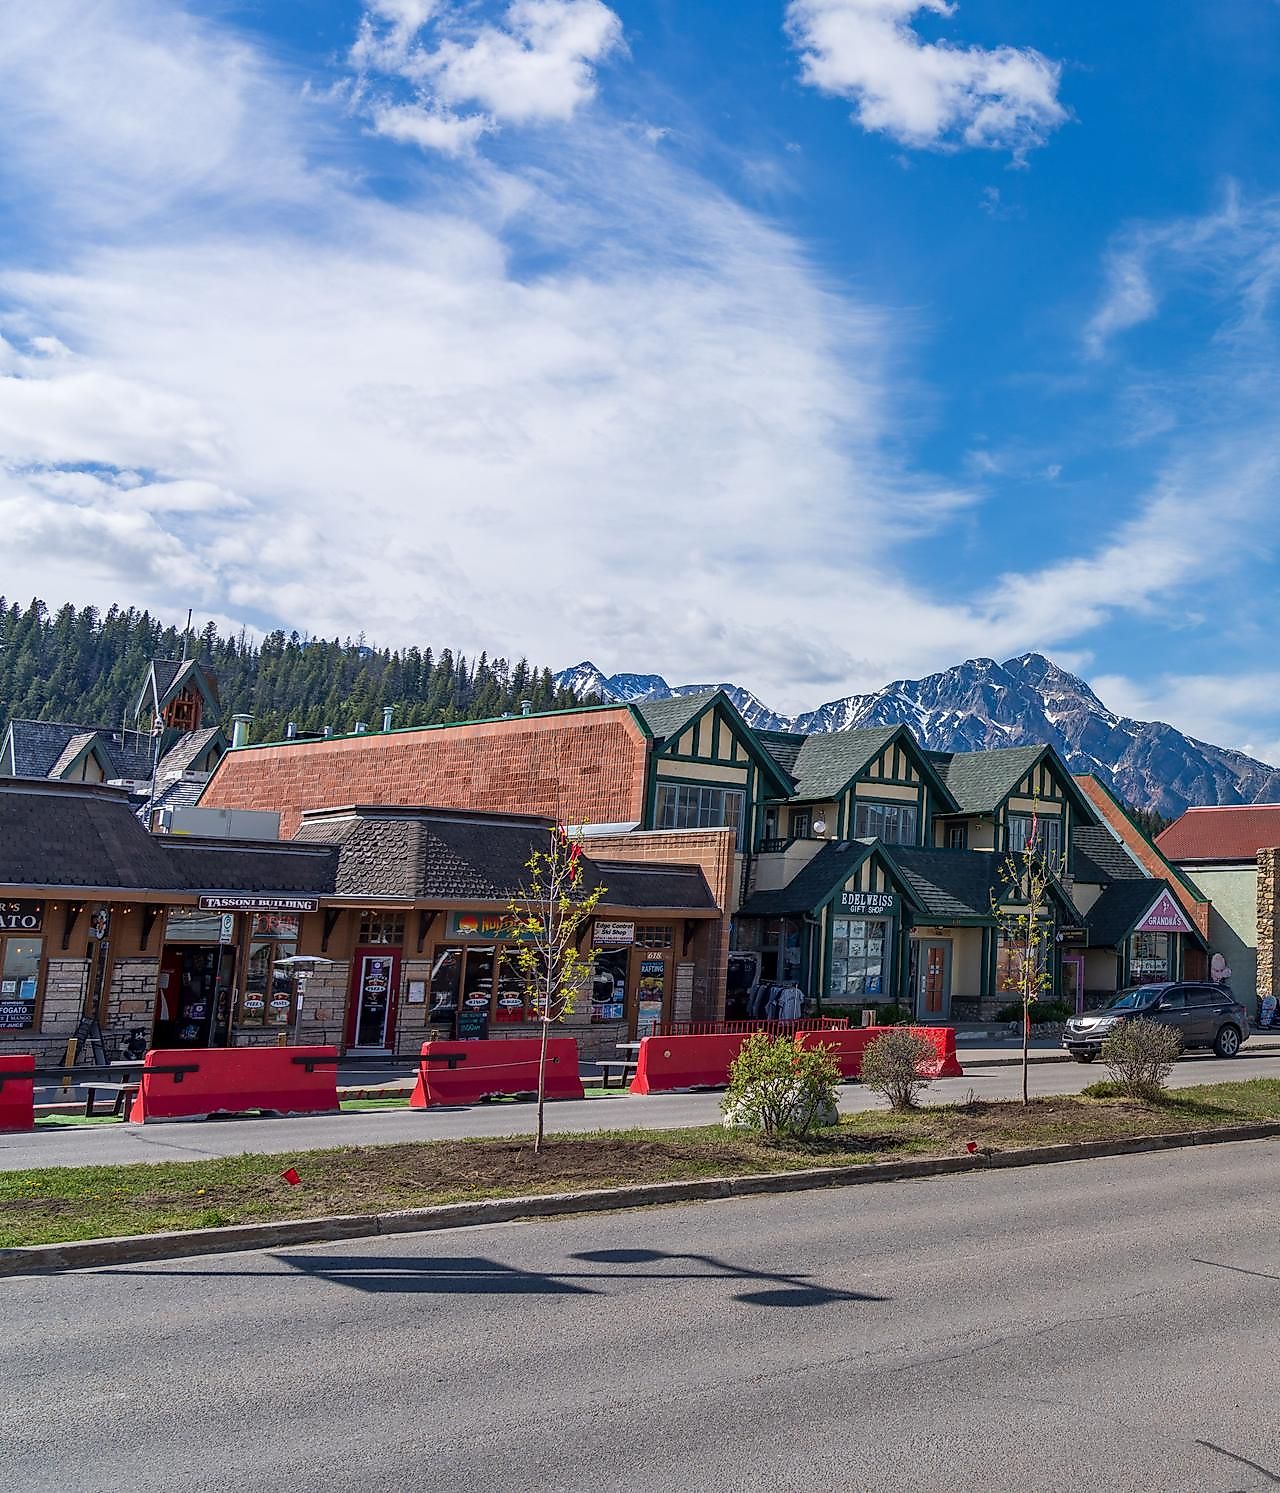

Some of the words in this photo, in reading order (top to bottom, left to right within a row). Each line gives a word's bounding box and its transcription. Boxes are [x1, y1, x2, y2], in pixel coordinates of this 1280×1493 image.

[206, 898, 256, 907] TASSONI
[259, 899, 312, 910] BUILDING
[841, 893, 893, 907] EDELWEISS
[850, 905, 865, 913] GIFT
[867, 906, 884, 914] SHOP
[1148, 914, 1181, 926] GRANDMA'S
